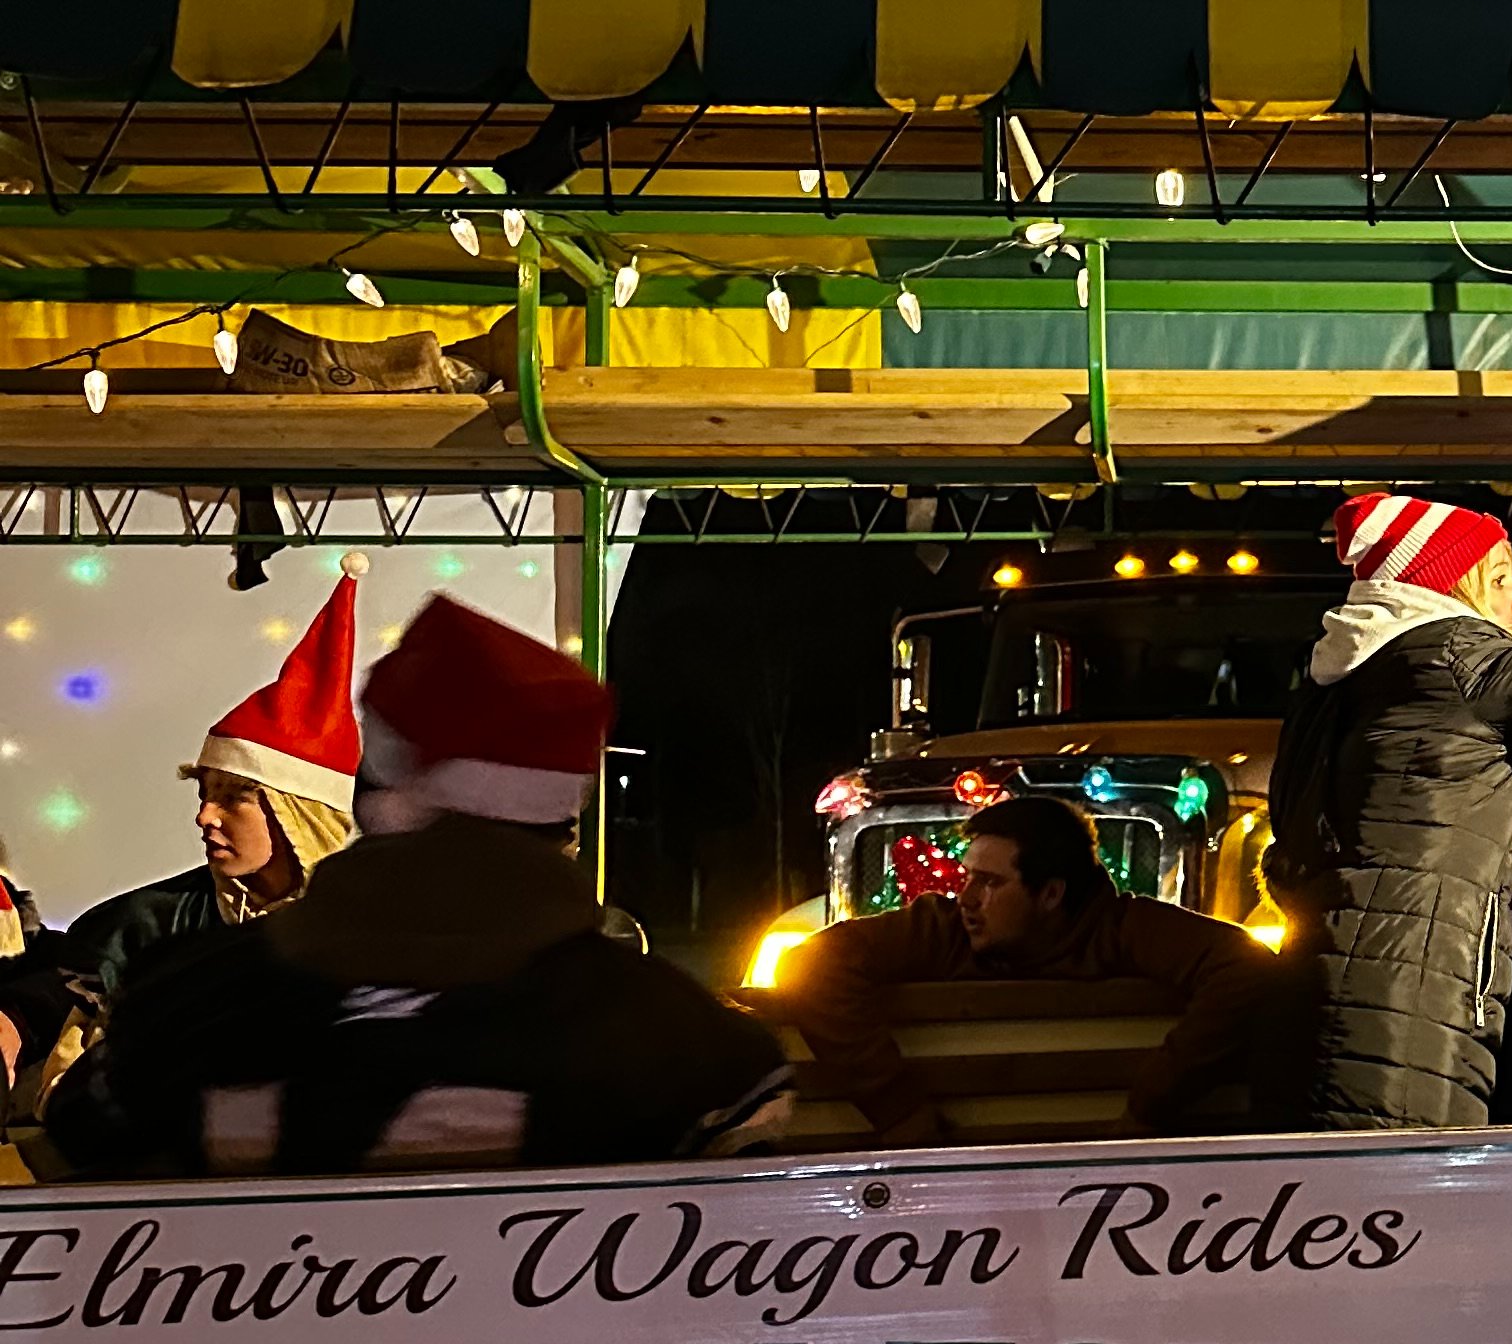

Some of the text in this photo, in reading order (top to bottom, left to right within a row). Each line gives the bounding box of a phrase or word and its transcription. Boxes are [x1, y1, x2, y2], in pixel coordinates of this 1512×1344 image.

[0, 1181, 1423, 1330] Elmira Wagon Rides
